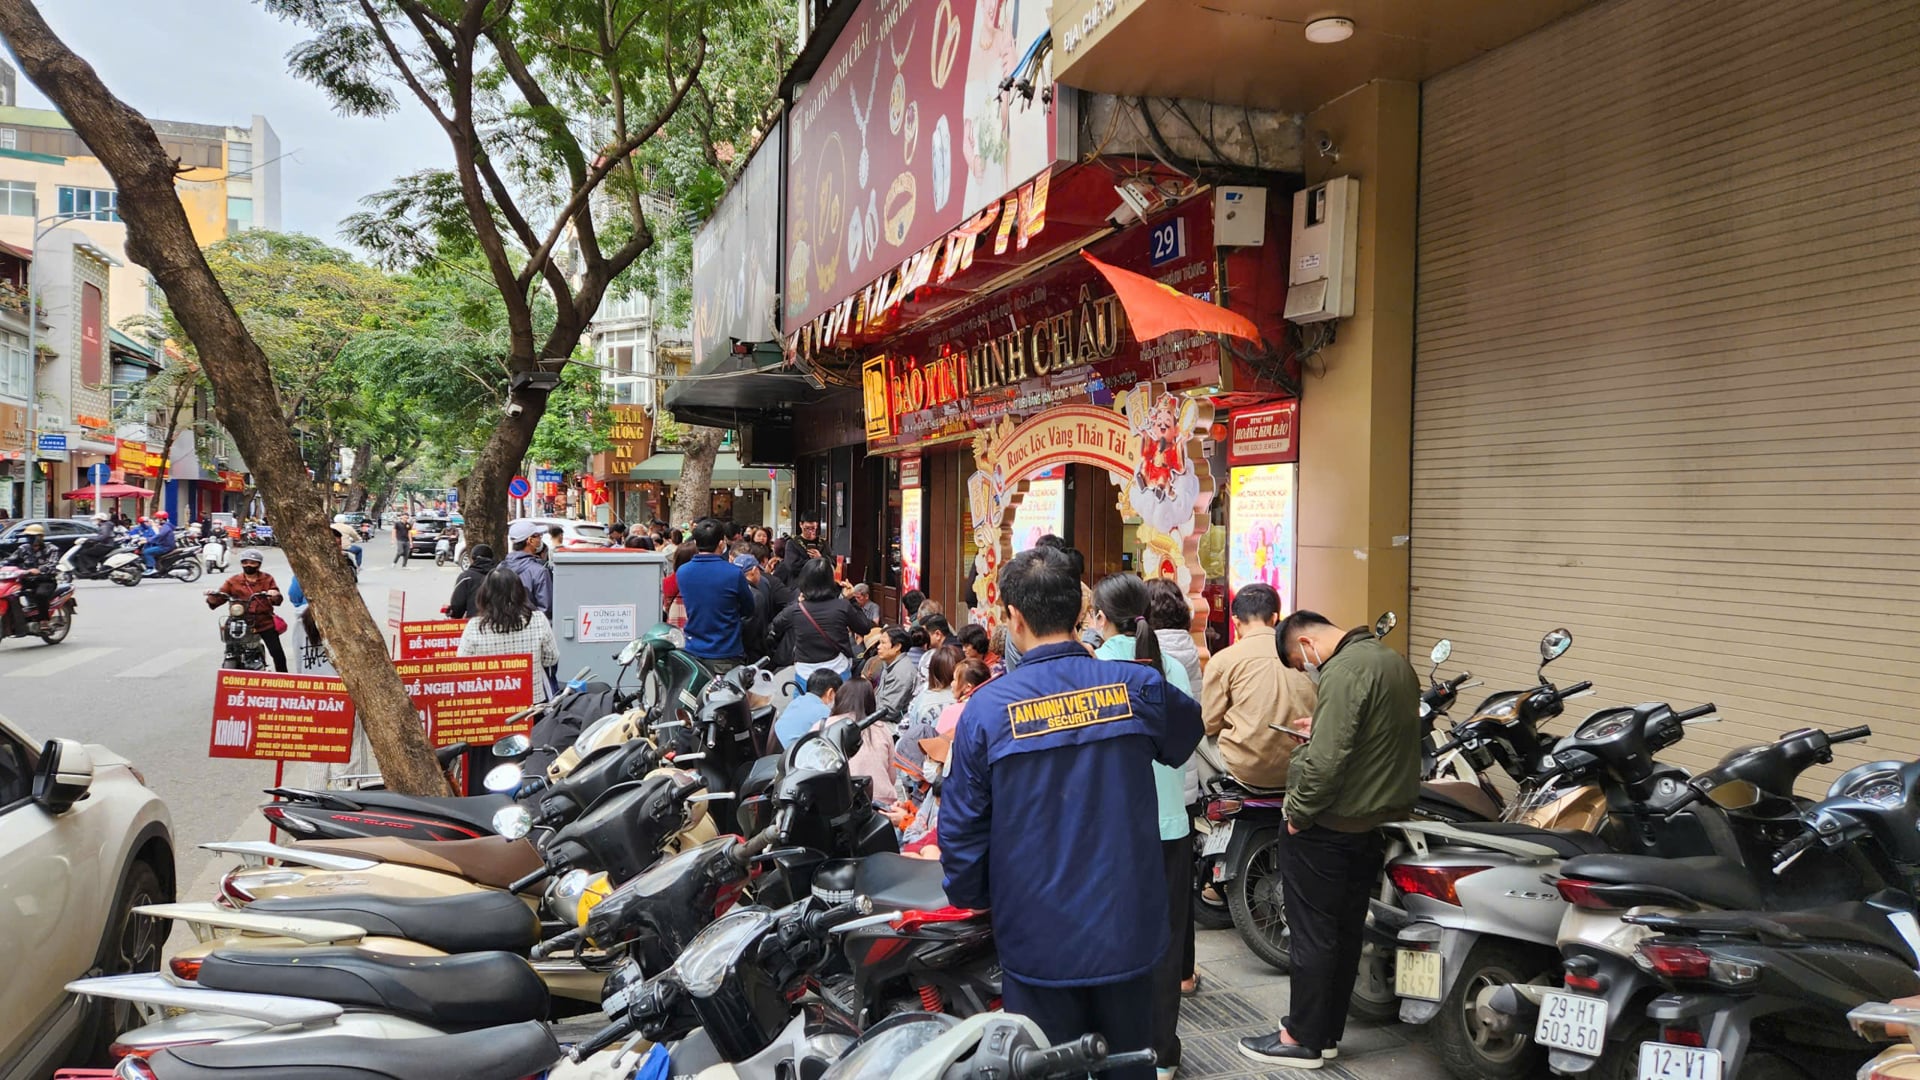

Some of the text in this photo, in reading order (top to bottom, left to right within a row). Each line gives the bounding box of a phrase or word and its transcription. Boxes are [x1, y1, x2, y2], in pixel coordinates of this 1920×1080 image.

[829, 53, 848, 97] MINH
[1154, 225, 1174, 259] 29
[891, 355, 923, 415] BẢO
[960, 329, 1027, 400] MINH
[1031, 283, 1118, 376] CHÂU
[616, 442, 633, 458] KỲ
[1007, 423, 1126, 469] Rước Lộc Vàng Thần Tài
[396, 659, 528, 674] CÔNG AN PHƯỜNG HAI BÀ TRƯNG
[222, 676, 348, 692] CÔNG AN PHƯỜNG HAI BÀ TRƯN
[424, 681, 455, 696] NGHỊ
[458, 677, 493, 694] NHÂN
[495, 675, 522, 691] DÂN
[227, 690, 345, 712] ĐỀ NGHỊ NHÂN DÂN
[214, 715, 246, 746] KHÔNG
[1048, 709, 1100, 729] SECURITY
[1550, 997, 1596, 1025] 29-H1
[1541, 1020, 1599, 1050] 503.50
[1654, 1048, 1706, 1080] 12-V1
